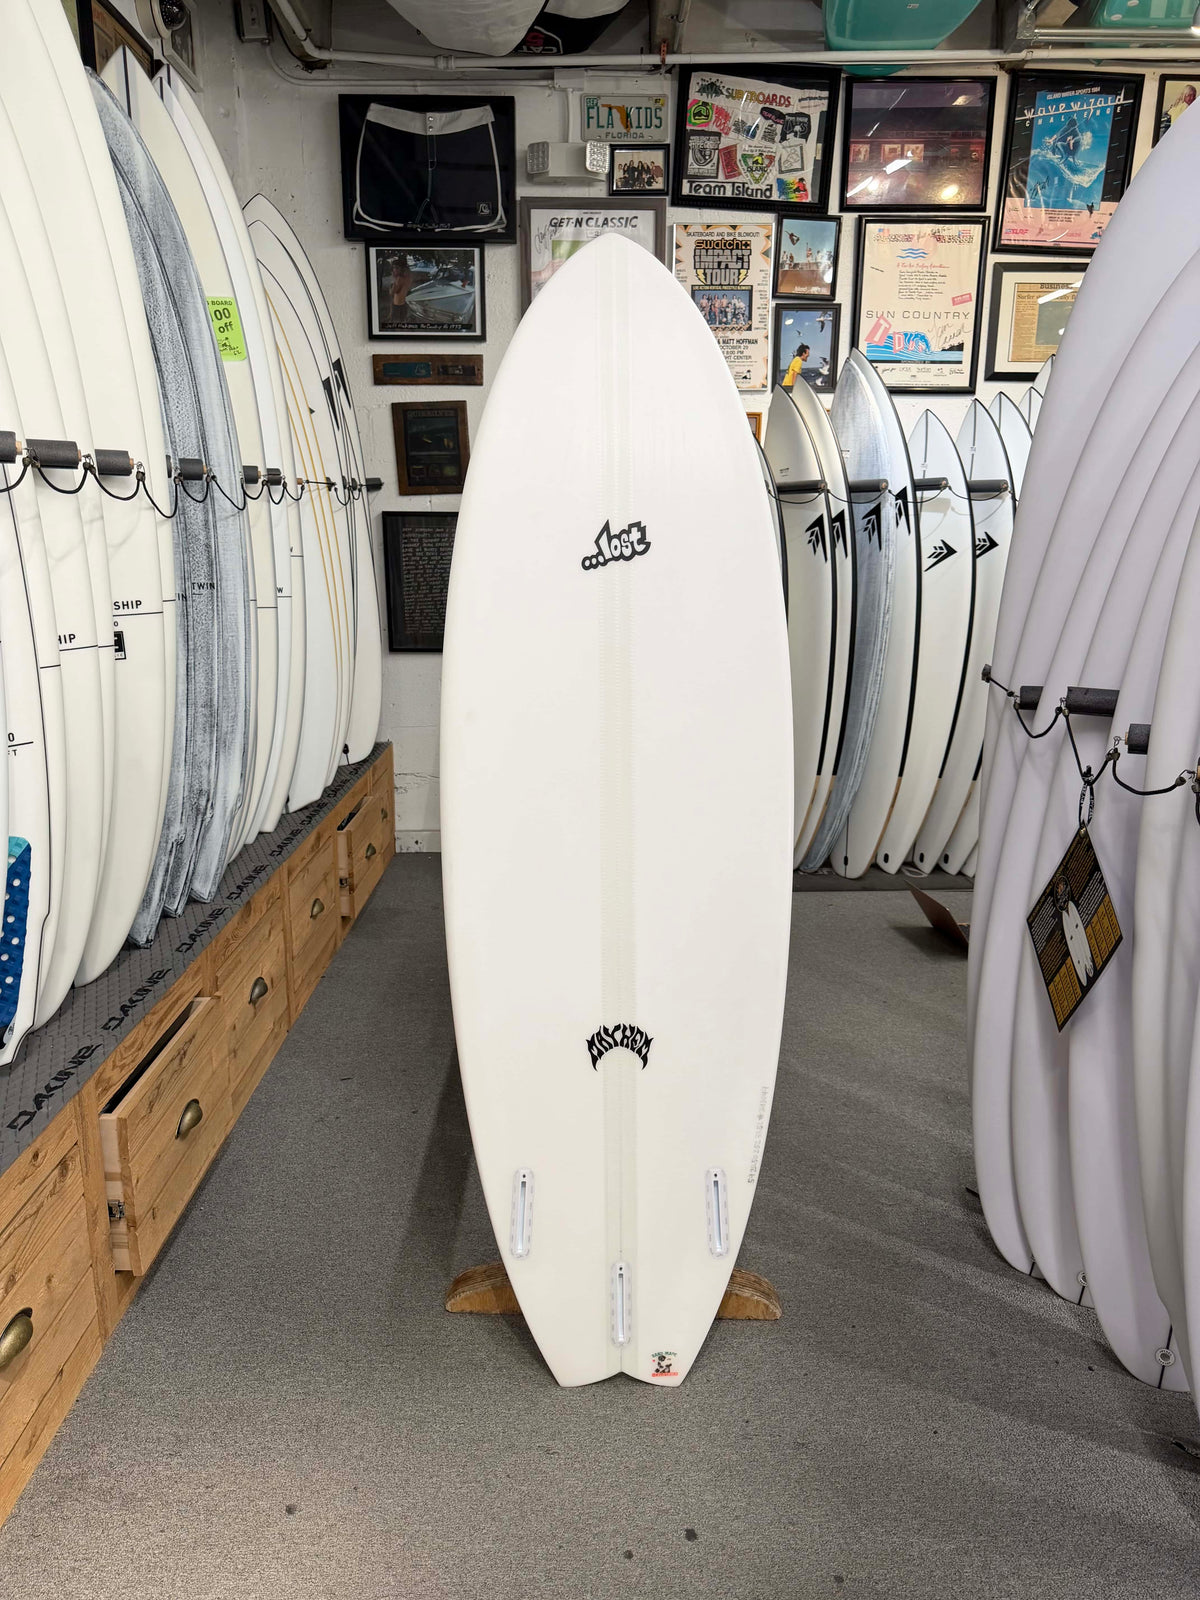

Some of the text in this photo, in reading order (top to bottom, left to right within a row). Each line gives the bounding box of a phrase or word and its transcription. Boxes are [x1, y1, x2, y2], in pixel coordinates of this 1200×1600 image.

[726, 87, 791, 107] SURFBOARDS
[1076, 88, 1091, 96] SPORTS
[626, 106, 664, 129] KIDS
[604, 131, 645, 139] FLORIDA
[687, 181, 727, 195] Team
[731, 181, 773, 199] Island
[585, 216, 639, 228] CLASSIC
[694, 238, 742, 250] swatch
[694, 249, 752, 269] IMPACT
[704, 269, 740, 285] TOUR
[865, 310, 971, 320] SUN COUNTRY
[218, 321, 234, 334] off
[191, 582, 216, 590] TWIN
[113, 600, 143, 610] SHIP
[226, 864, 270, 902] DAKINE
[175, 906, 229, 954] DAKINE
[101, 968, 172, 1031] DAKINE
[6, 1043, 103, 1131] DAKINE
